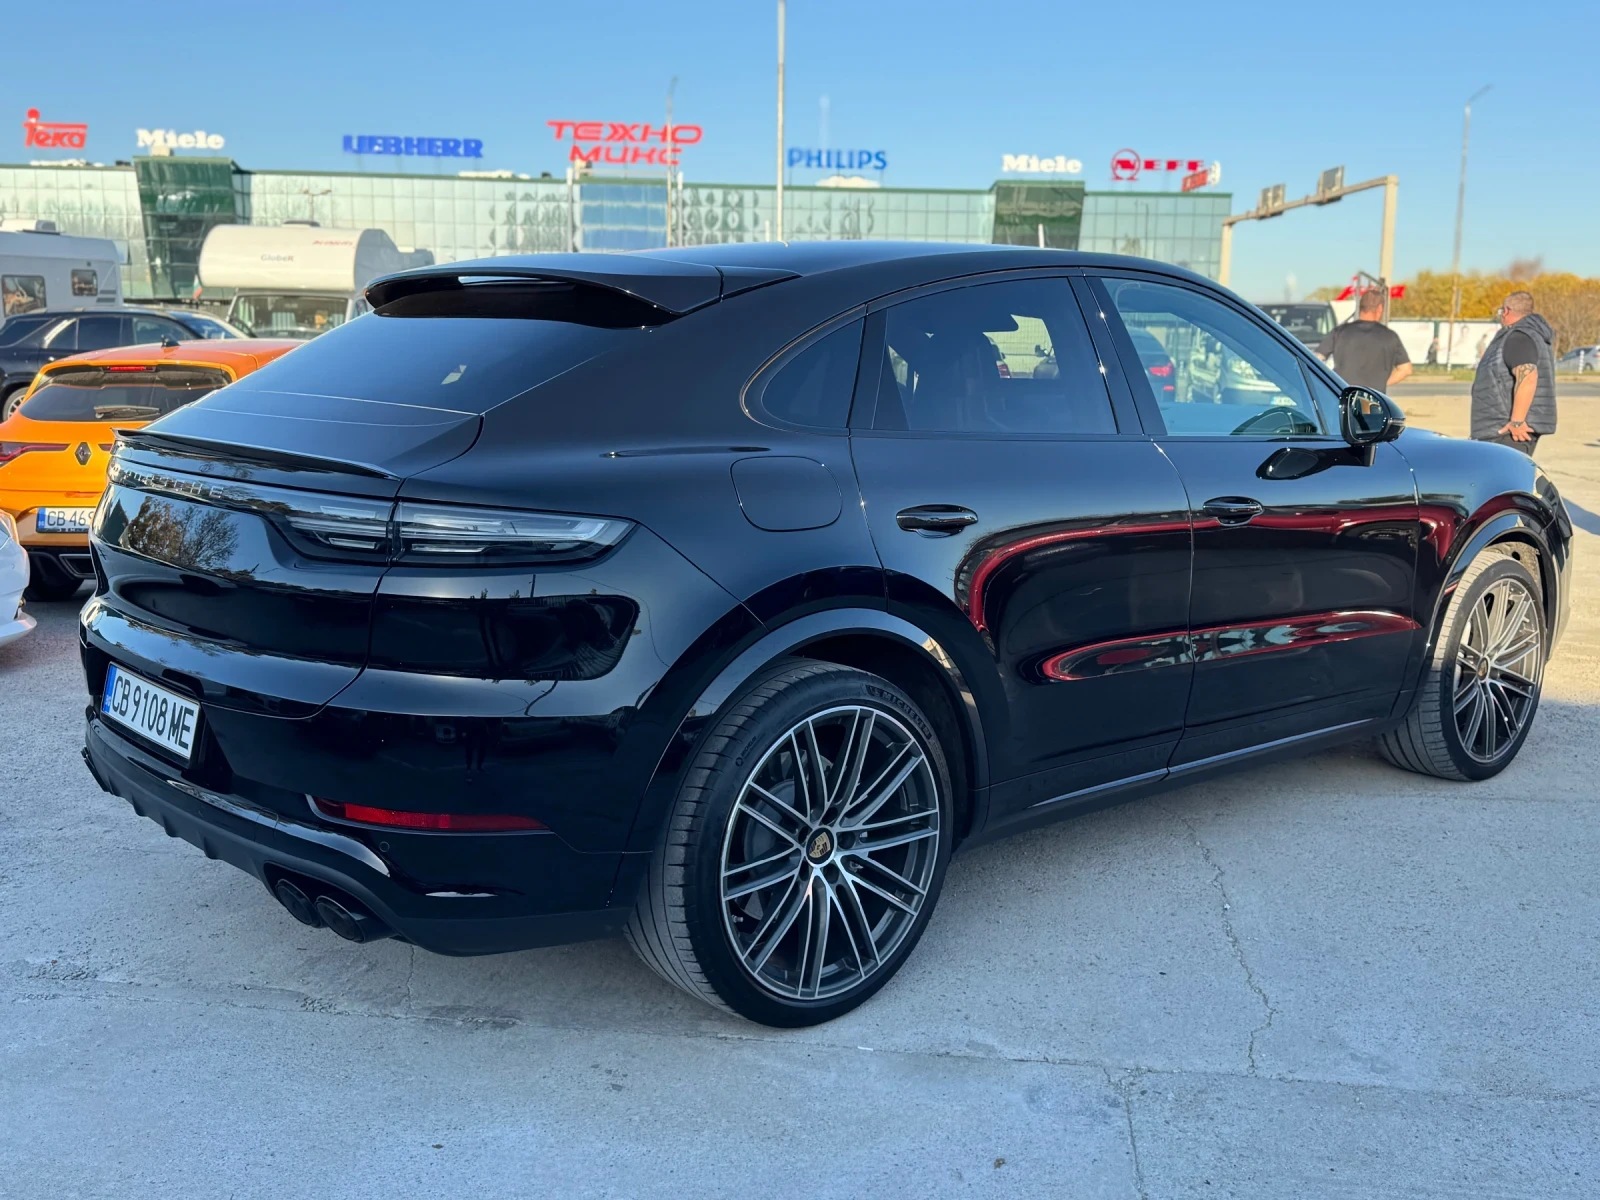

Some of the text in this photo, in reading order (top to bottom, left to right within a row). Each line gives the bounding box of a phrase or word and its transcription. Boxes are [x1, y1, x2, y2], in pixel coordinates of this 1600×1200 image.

[136, 128, 225, 149] Miele
[343, 135, 483, 158] LIEBHERR
[787, 148, 888, 170] PHILIPS
[1003, 154, 1083, 174] Miele
[47, 511, 66, 526] CB
[112, 675, 195, 750] CB 9108 ME
